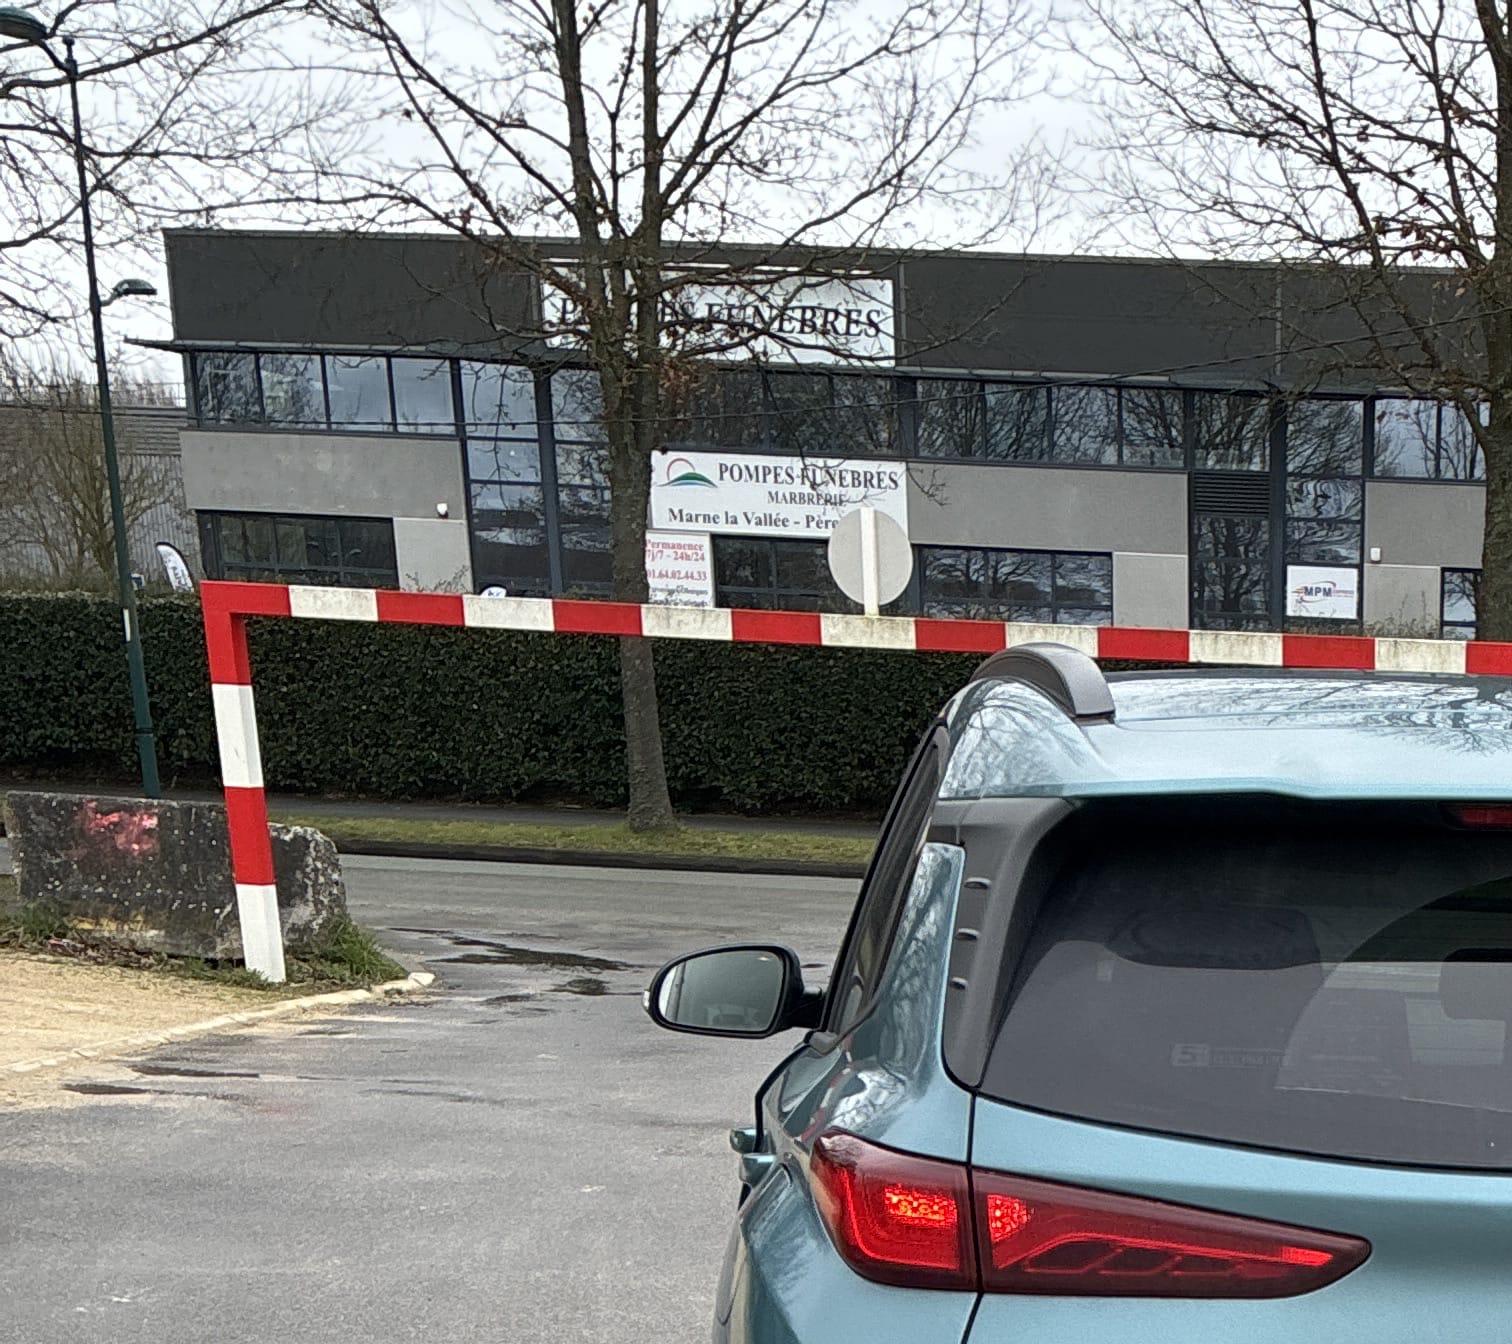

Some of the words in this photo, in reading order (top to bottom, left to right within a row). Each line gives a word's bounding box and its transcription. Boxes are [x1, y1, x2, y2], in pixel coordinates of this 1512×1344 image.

[718, 462, 795, 486] POMPES
[768, 490, 847, 507] MARBRERIE
[668, 508, 719, 525] Marne
[724, 510, 738, 525] la
[743, 512, 790, 528] Vallée
[1304, 586, 1333, 598] MPM
